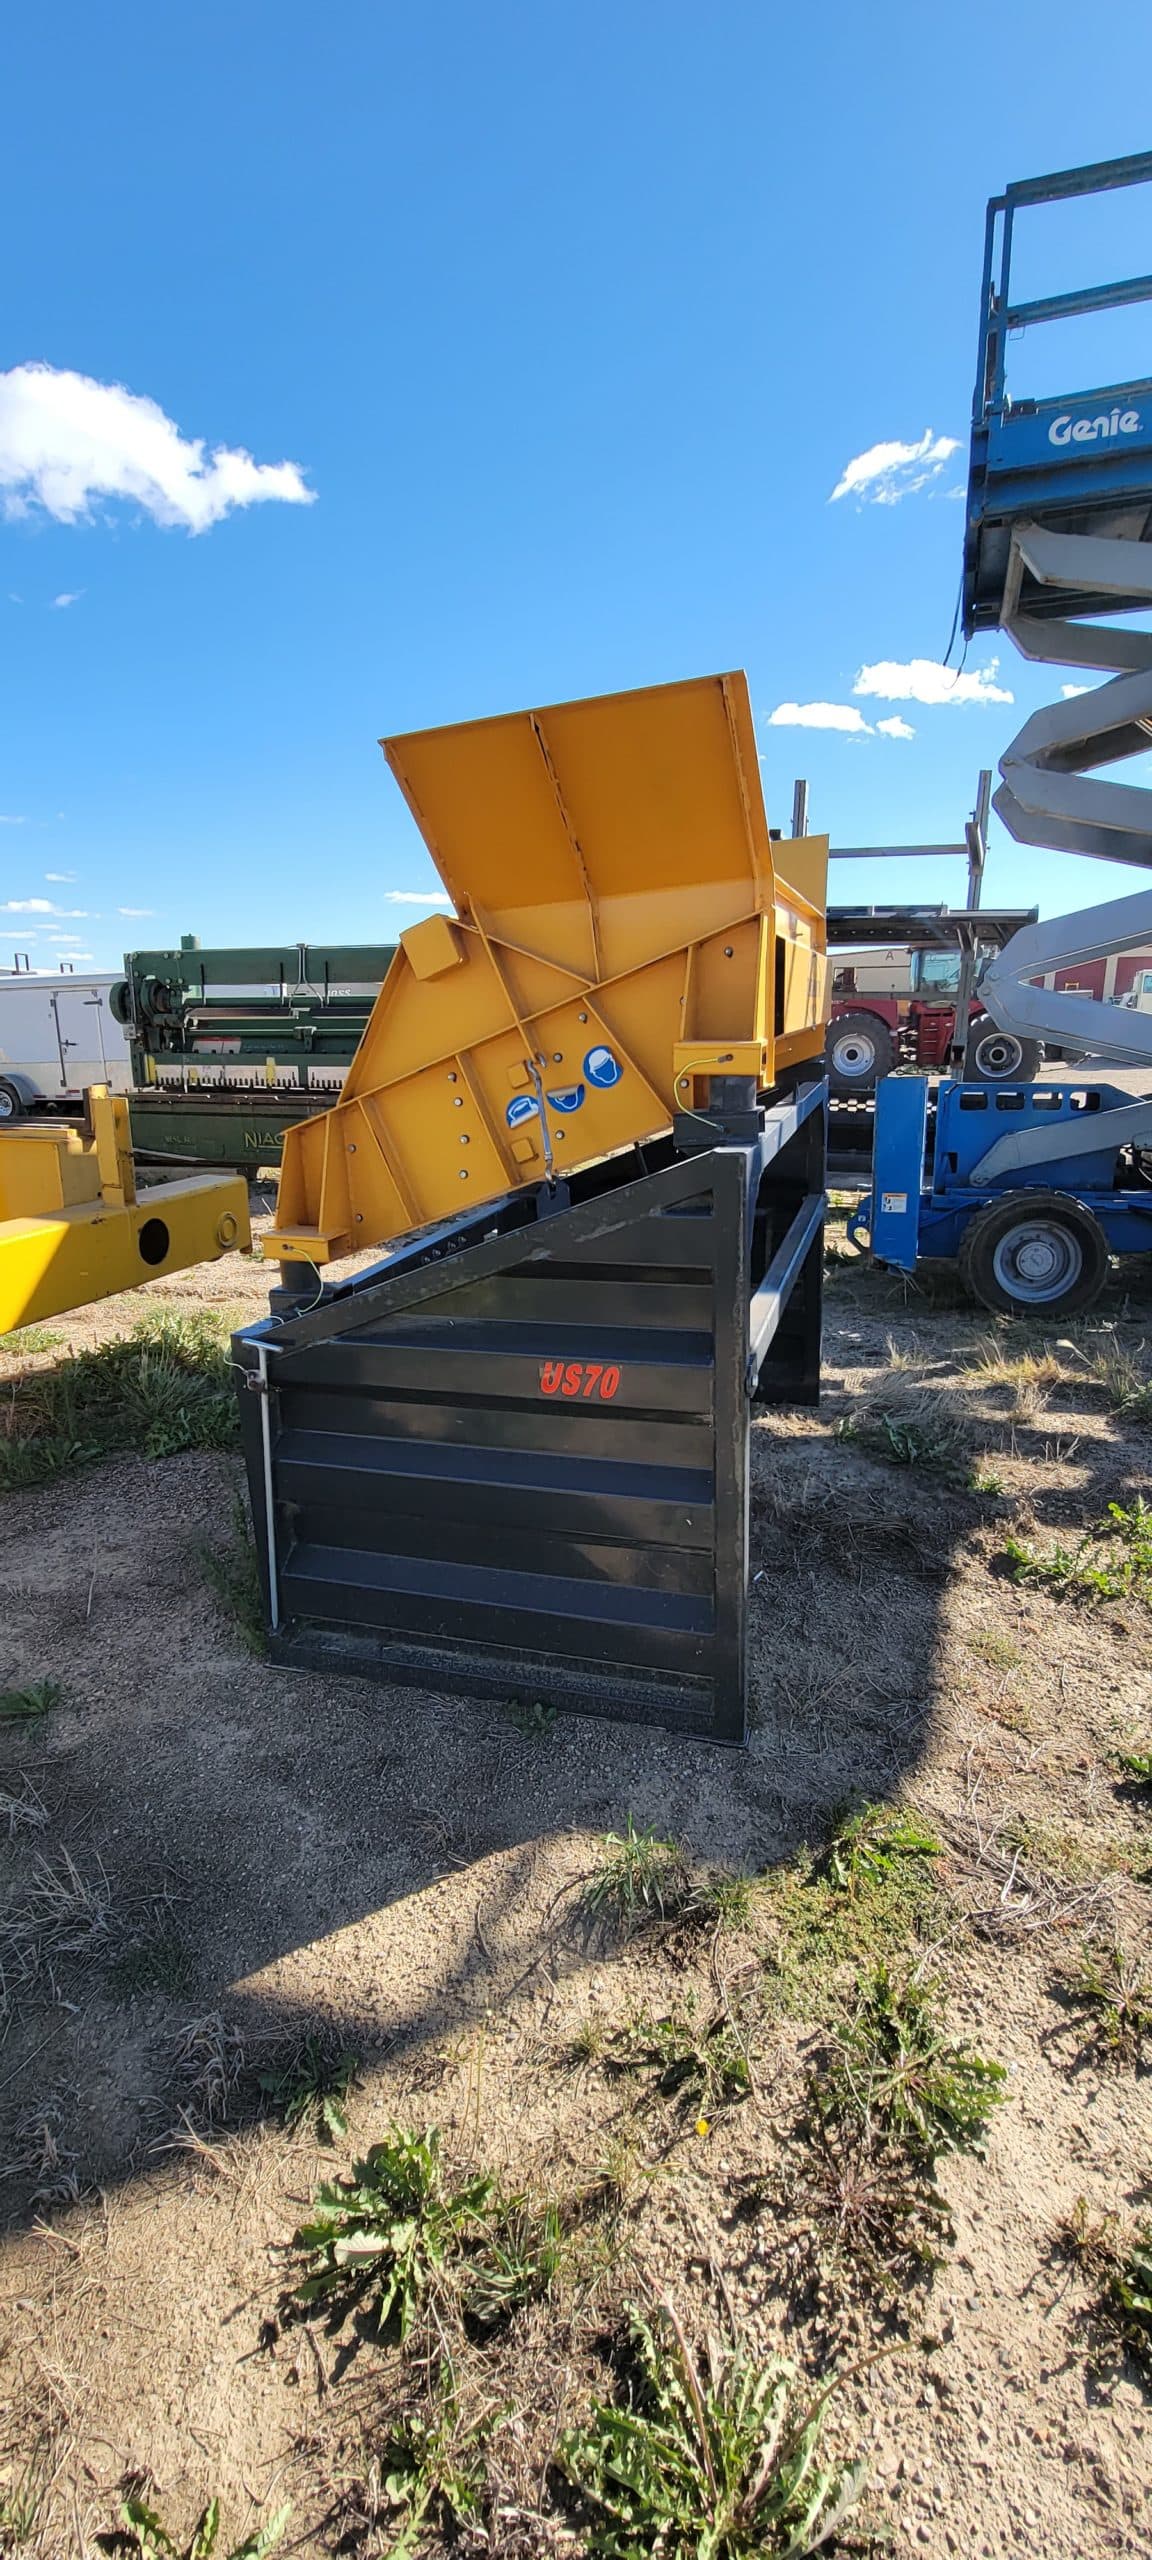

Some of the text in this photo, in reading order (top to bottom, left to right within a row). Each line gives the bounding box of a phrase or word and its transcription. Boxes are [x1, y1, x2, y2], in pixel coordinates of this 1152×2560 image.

[1048, 408, 1140, 446] Genie
[885, 951, 894, 961] A
[541, 1361, 620, 1399] US70
